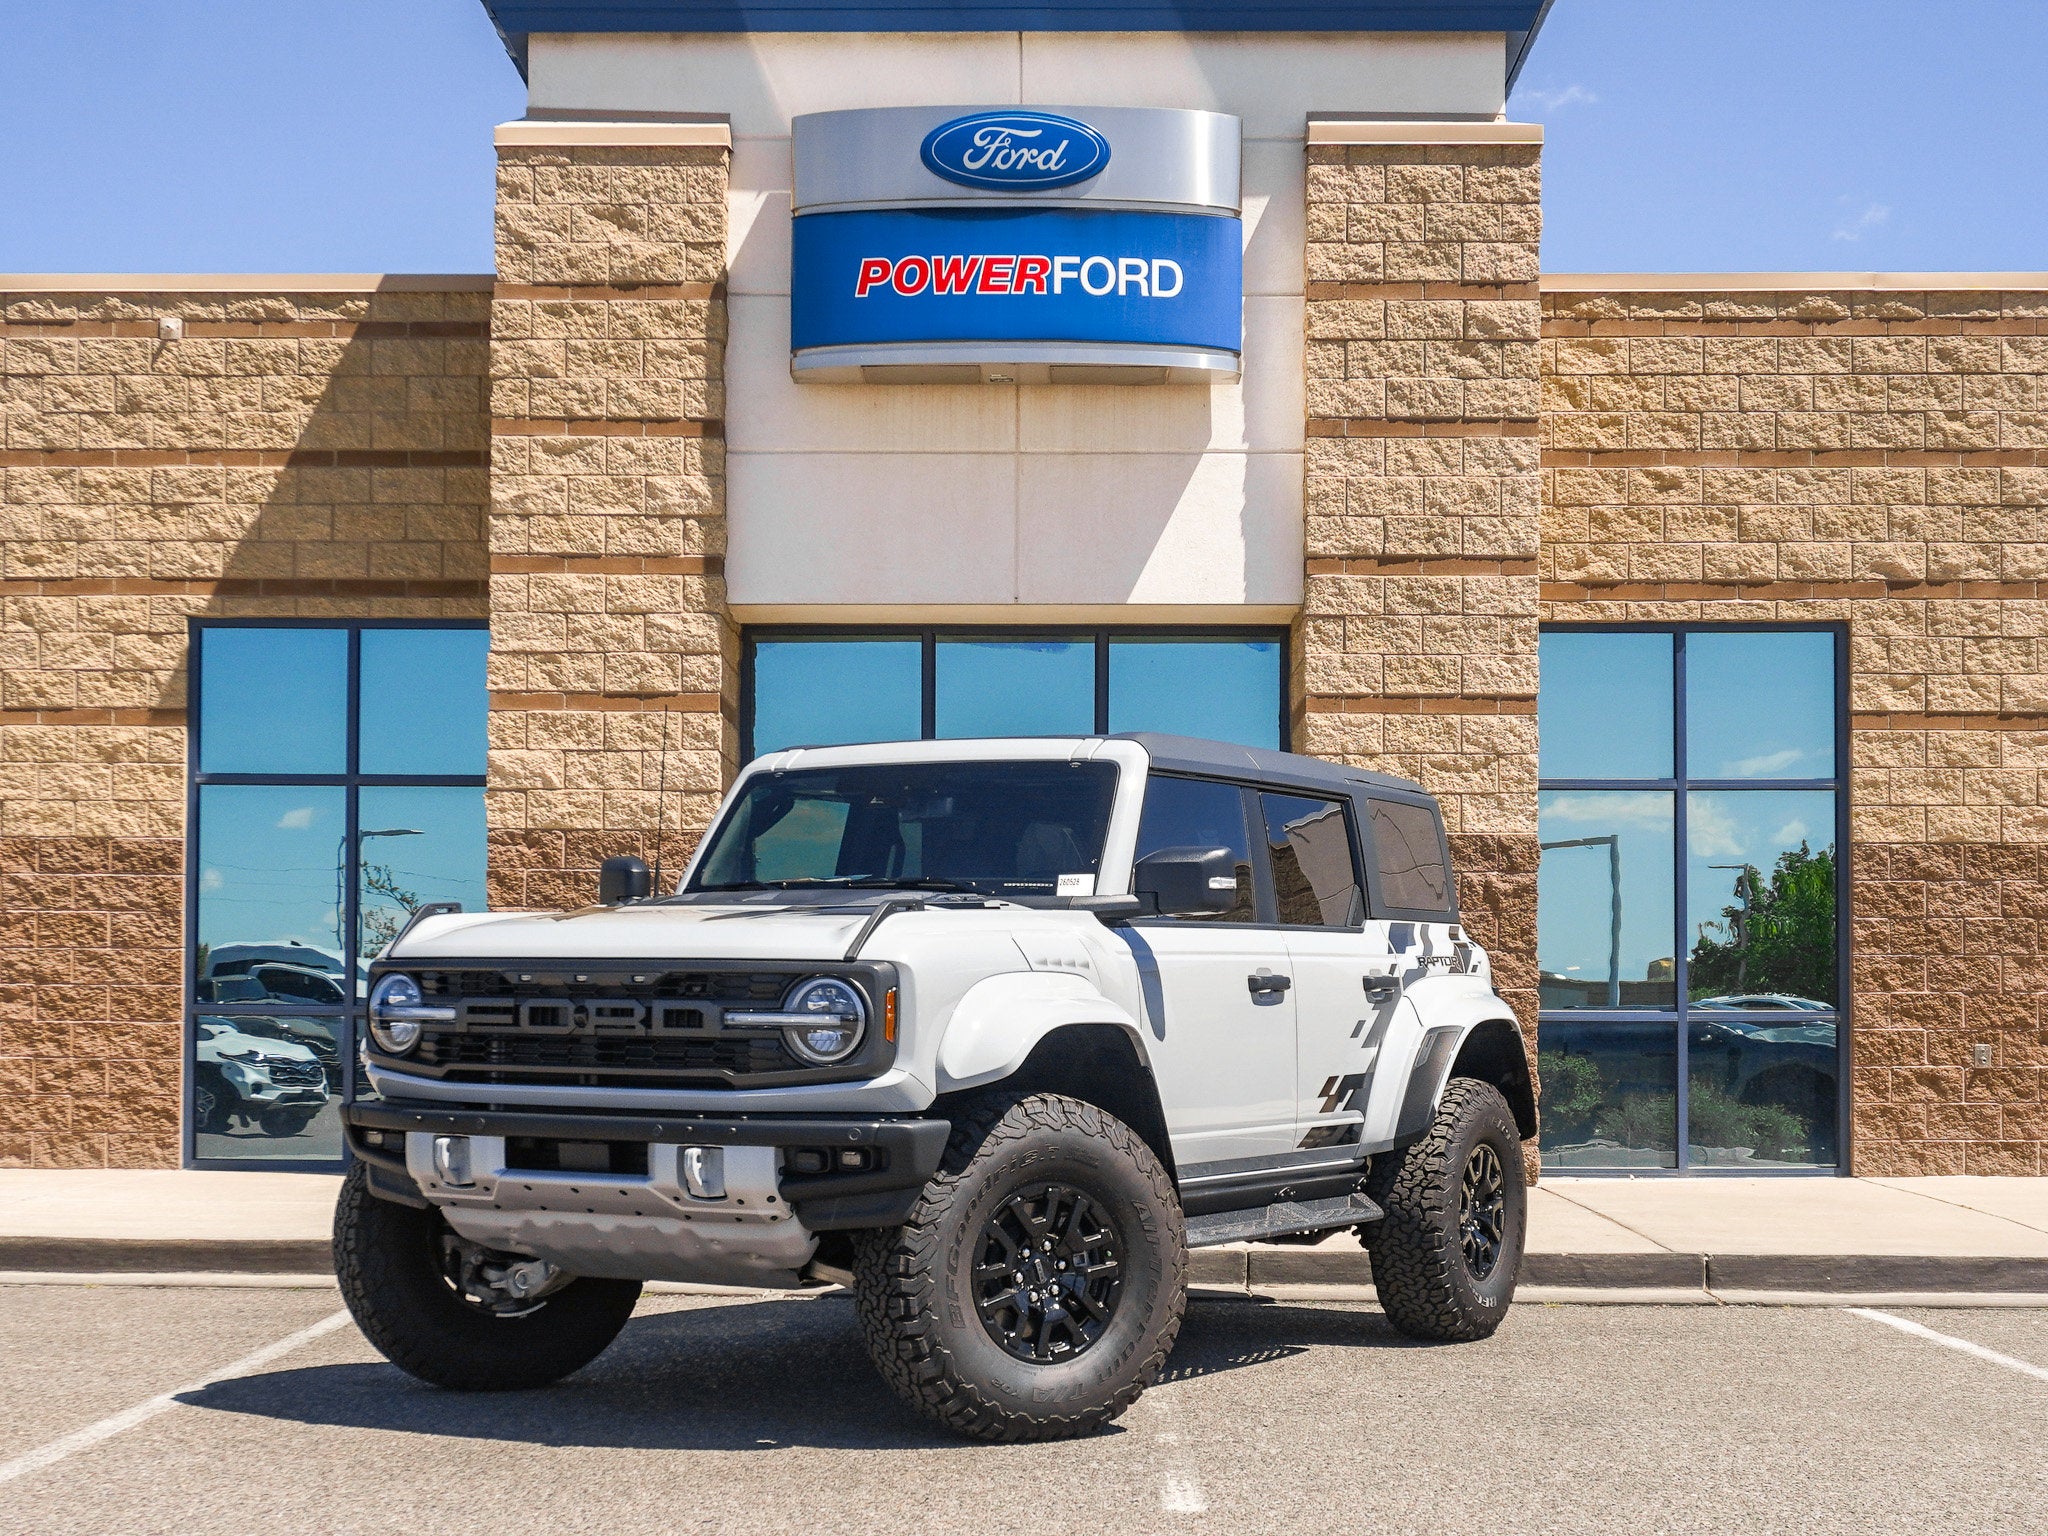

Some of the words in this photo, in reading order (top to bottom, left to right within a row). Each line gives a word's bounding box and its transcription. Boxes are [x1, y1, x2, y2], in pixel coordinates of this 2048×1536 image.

[962, 126, 1068, 172] Ford
[1416, 955, 1463, 972] RAPTOR
[458, 998, 721, 1036] FORD
